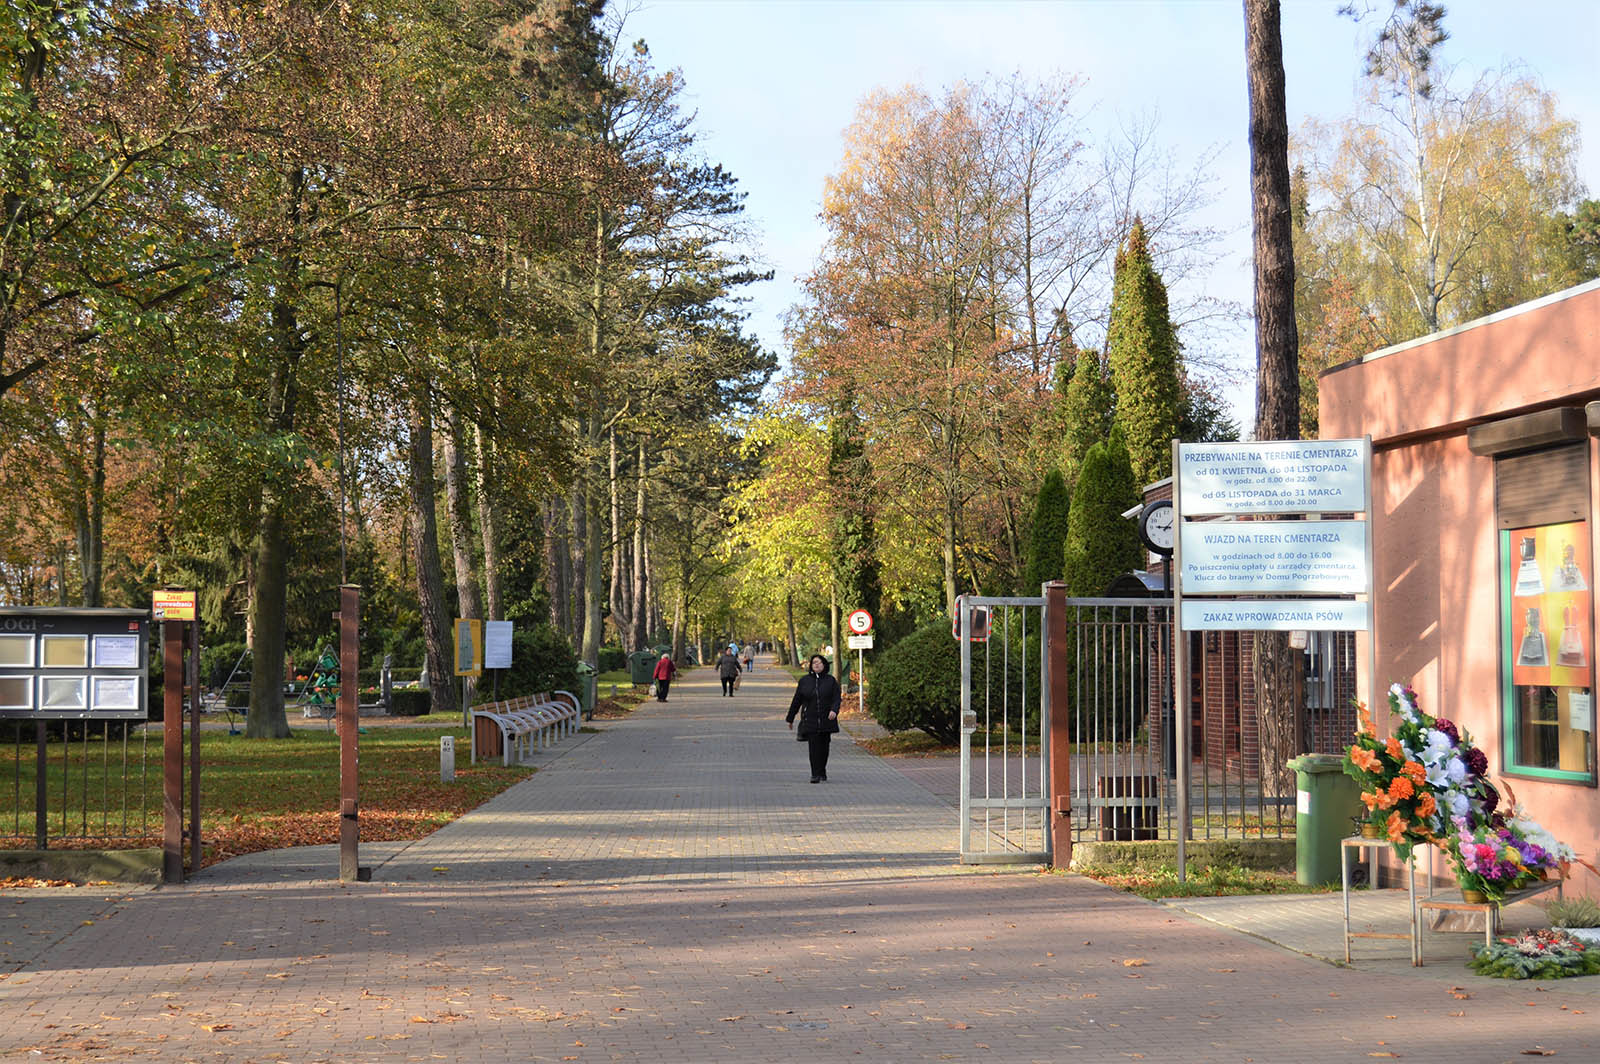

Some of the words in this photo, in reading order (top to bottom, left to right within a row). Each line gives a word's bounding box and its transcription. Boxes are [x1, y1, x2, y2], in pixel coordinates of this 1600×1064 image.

[1185, 452, 1246, 462] PRZEBYWANIE
[1304, 449, 1358, 459] CMENTARZA
[1234, 478, 1253, 486] godz.
[1234, 501, 1253, 509] godz.
[1204, 535, 1235, 543] WJAZD
[1254, 534, 1281, 543] TEREN
[1285, 534, 1340, 542] CMENTARZA
[1222, 553, 1262, 561] godzinach
[1242, 564, 1266, 572] opłaty
[1229, 574, 1254, 582] bramy
[1204, 613, 1232, 622] ZAKAZ
[1236, 613, 1312, 621] WPROWADZANIA
[1316, 611, 1343, 621] PSÓW
[857, 617, 864, 627] 5
